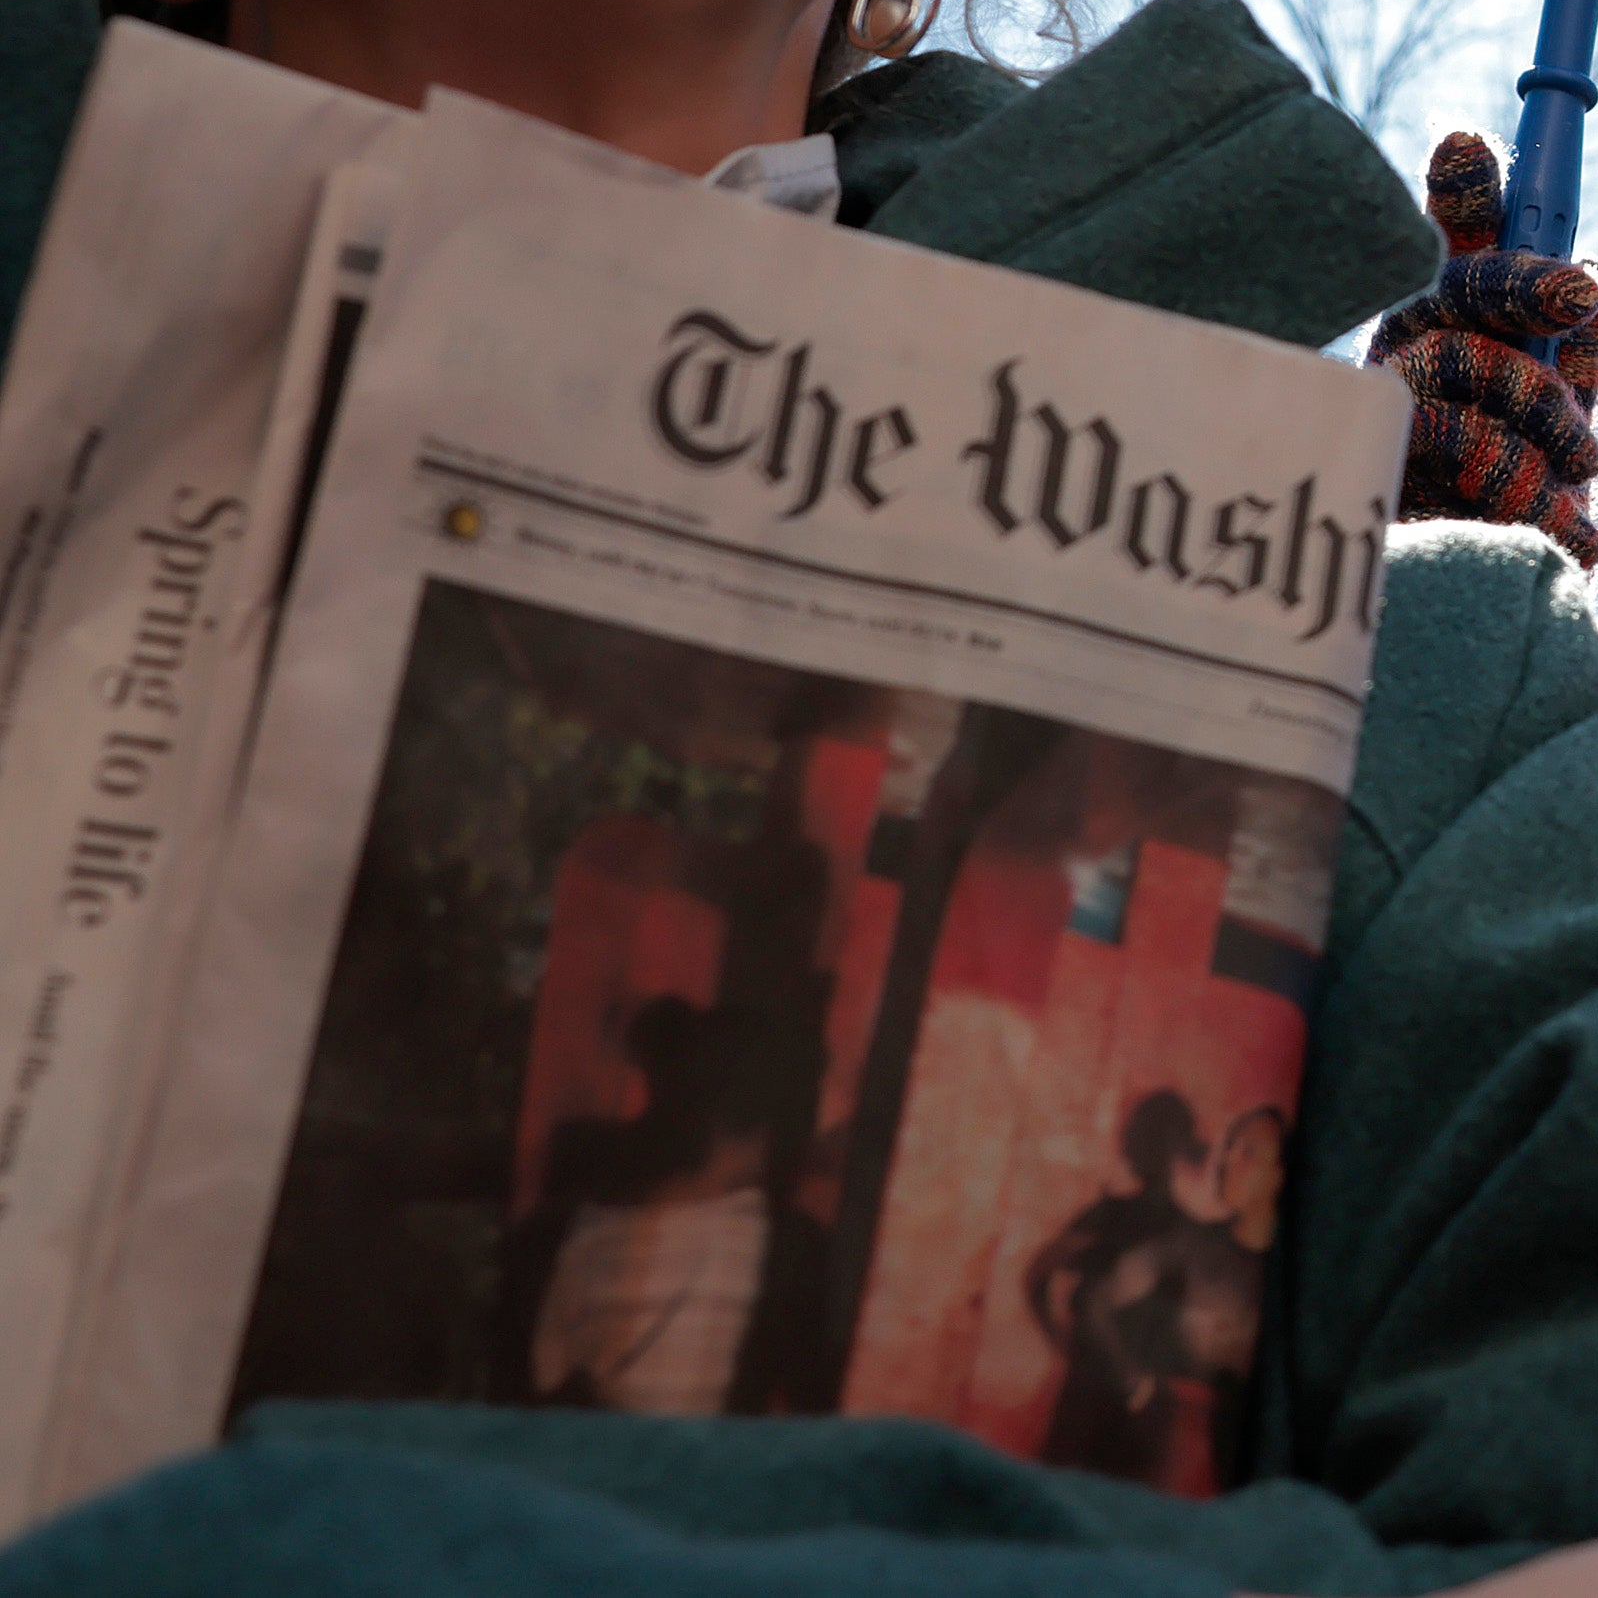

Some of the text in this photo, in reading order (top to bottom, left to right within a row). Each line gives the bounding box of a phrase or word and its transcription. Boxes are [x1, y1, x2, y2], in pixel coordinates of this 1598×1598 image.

[650, 308, 921, 524] The
[63, 482, 246, 930] Spring to life
